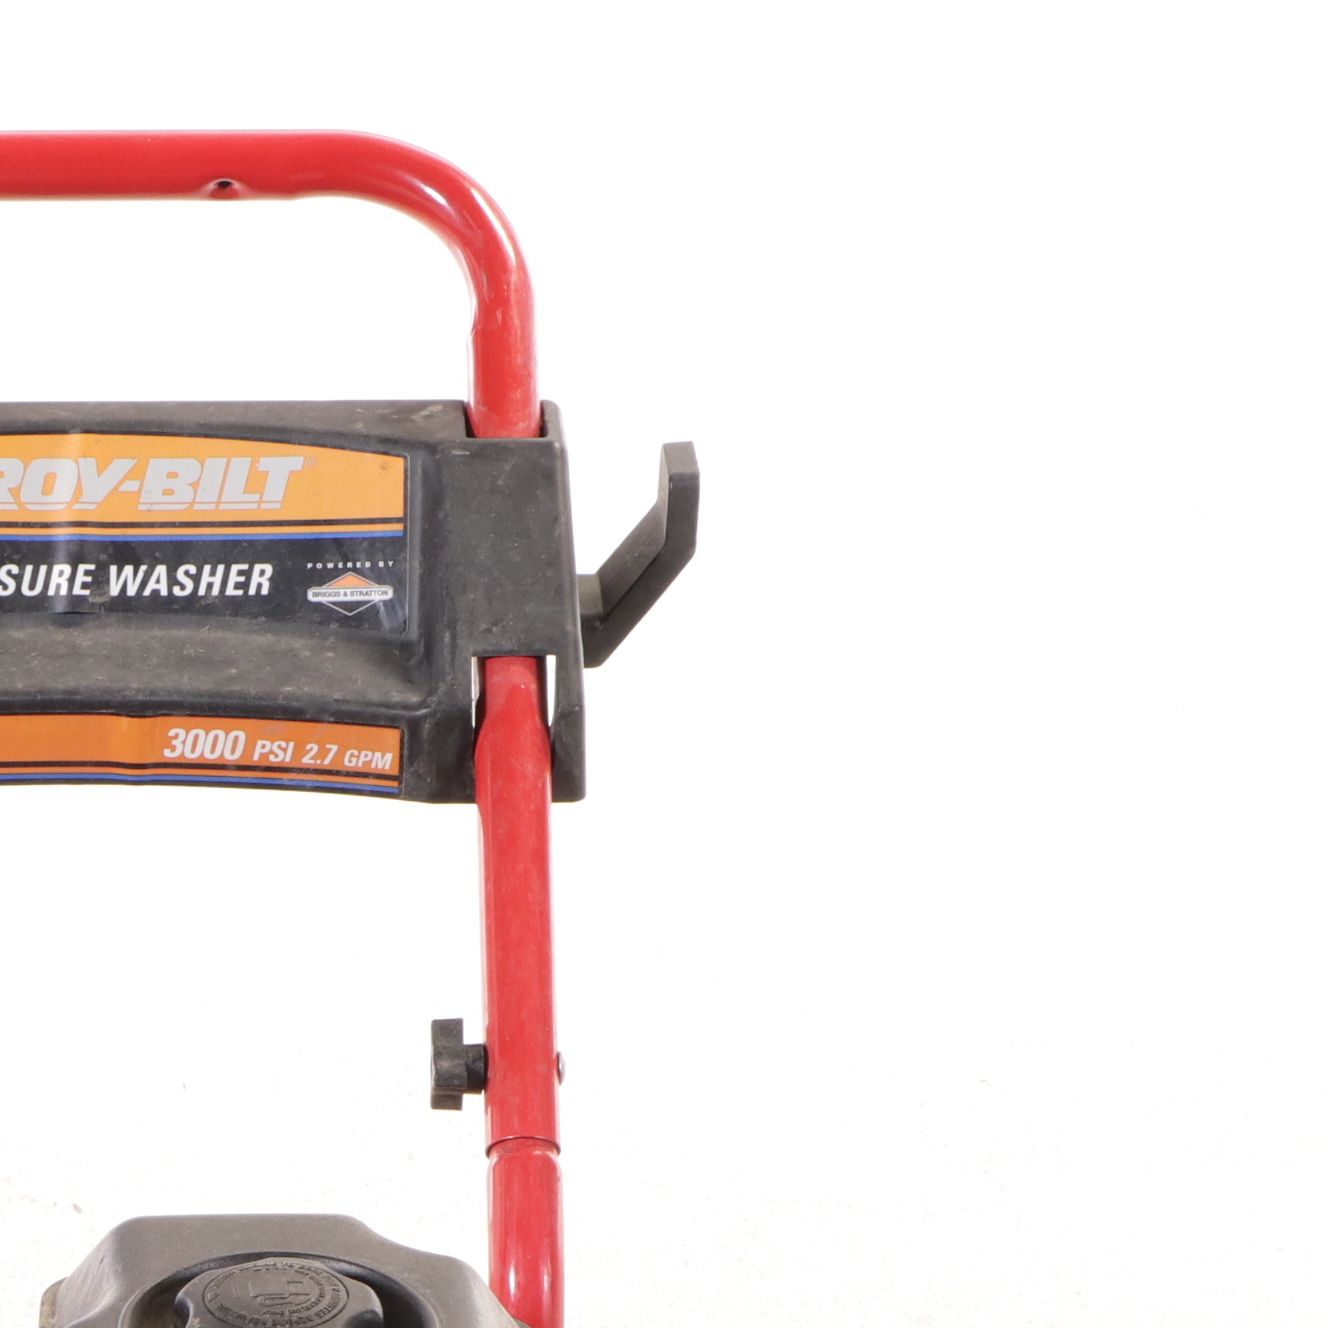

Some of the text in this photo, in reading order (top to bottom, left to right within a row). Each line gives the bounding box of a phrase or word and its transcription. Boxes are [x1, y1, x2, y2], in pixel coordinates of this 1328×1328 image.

[307, 560, 394, 569] POWERED BY
[109, 563, 273, 597] WASHER
[312, 590, 341, 598] BRIGGS
[350, 589, 389, 597] STRATTON
[163, 727, 393, 769] 3000 PSI 2.7 GPM
